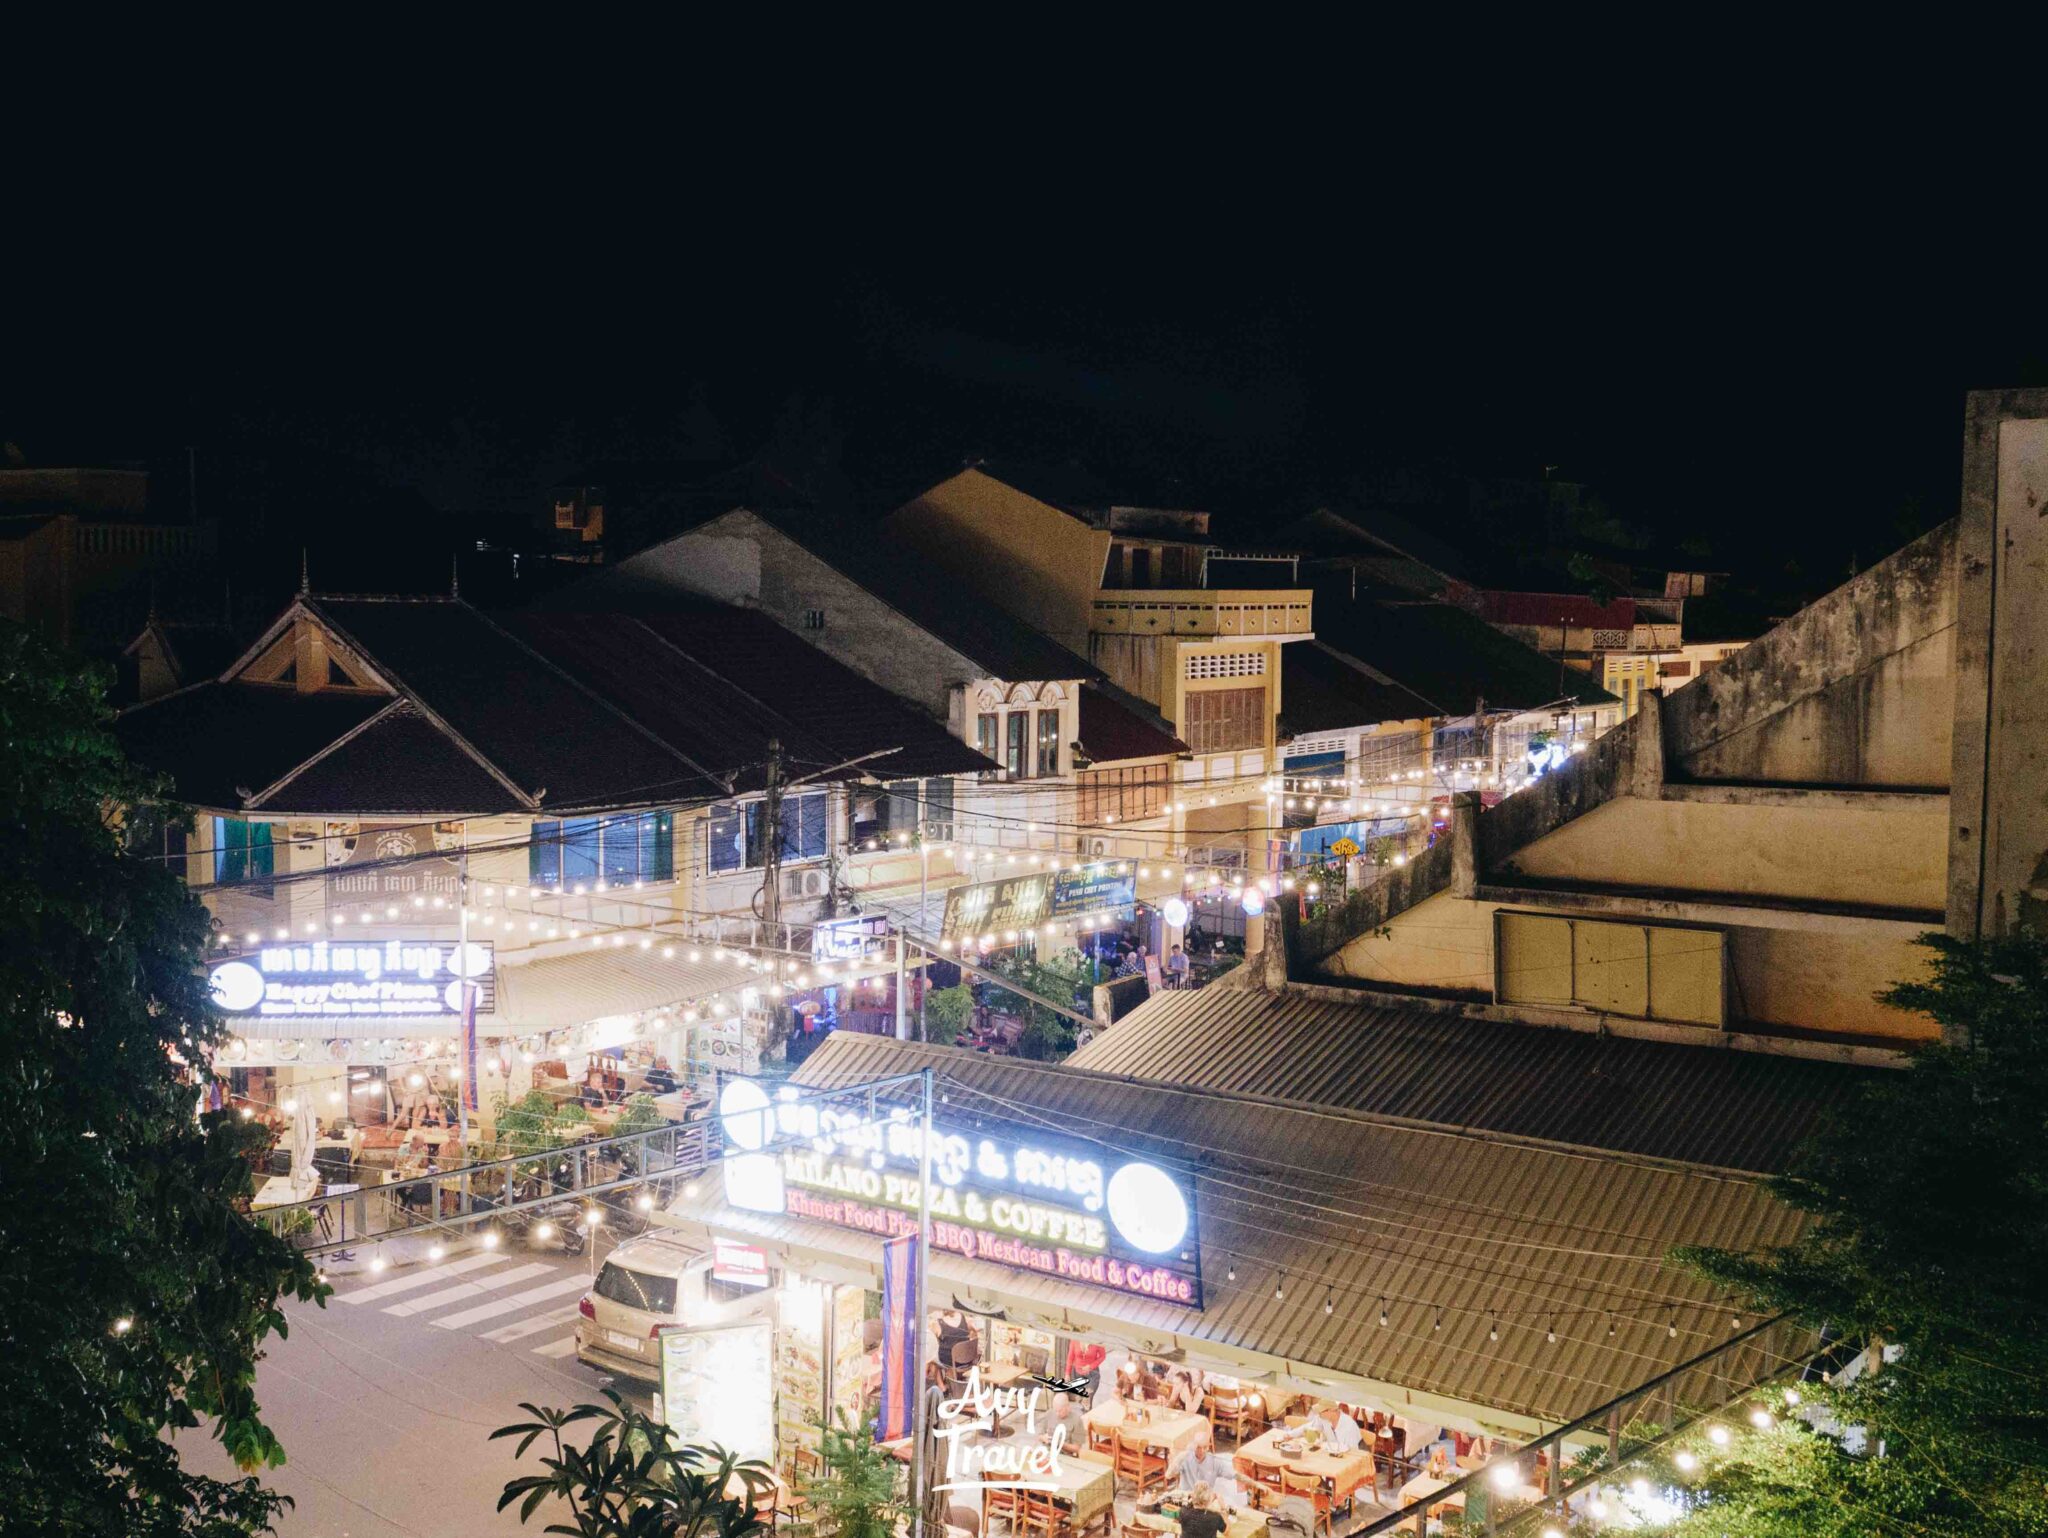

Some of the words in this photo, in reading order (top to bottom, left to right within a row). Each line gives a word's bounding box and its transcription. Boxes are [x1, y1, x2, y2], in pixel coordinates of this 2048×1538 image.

[784, 1149, 880, 1198] MILANO
[884, 1174, 960, 1217] PIZZA
[964, 1191, 987, 1222] &
[991, 1198, 1108, 1249] COFFEE
[977, 1140, 1008, 1180] &
[786, 1189, 843, 1220] Khmer
[844, 1200, 887, 1232] Food
[935, 1221, 977, 1258] BBQ
[977, 1231, 1055, 1270] Mexican
[1056, 1248, 1105, 1283] Food
[1107, 1260, 1124, 1286] &
[1126, 1265, 1192, 1300] Coffee
